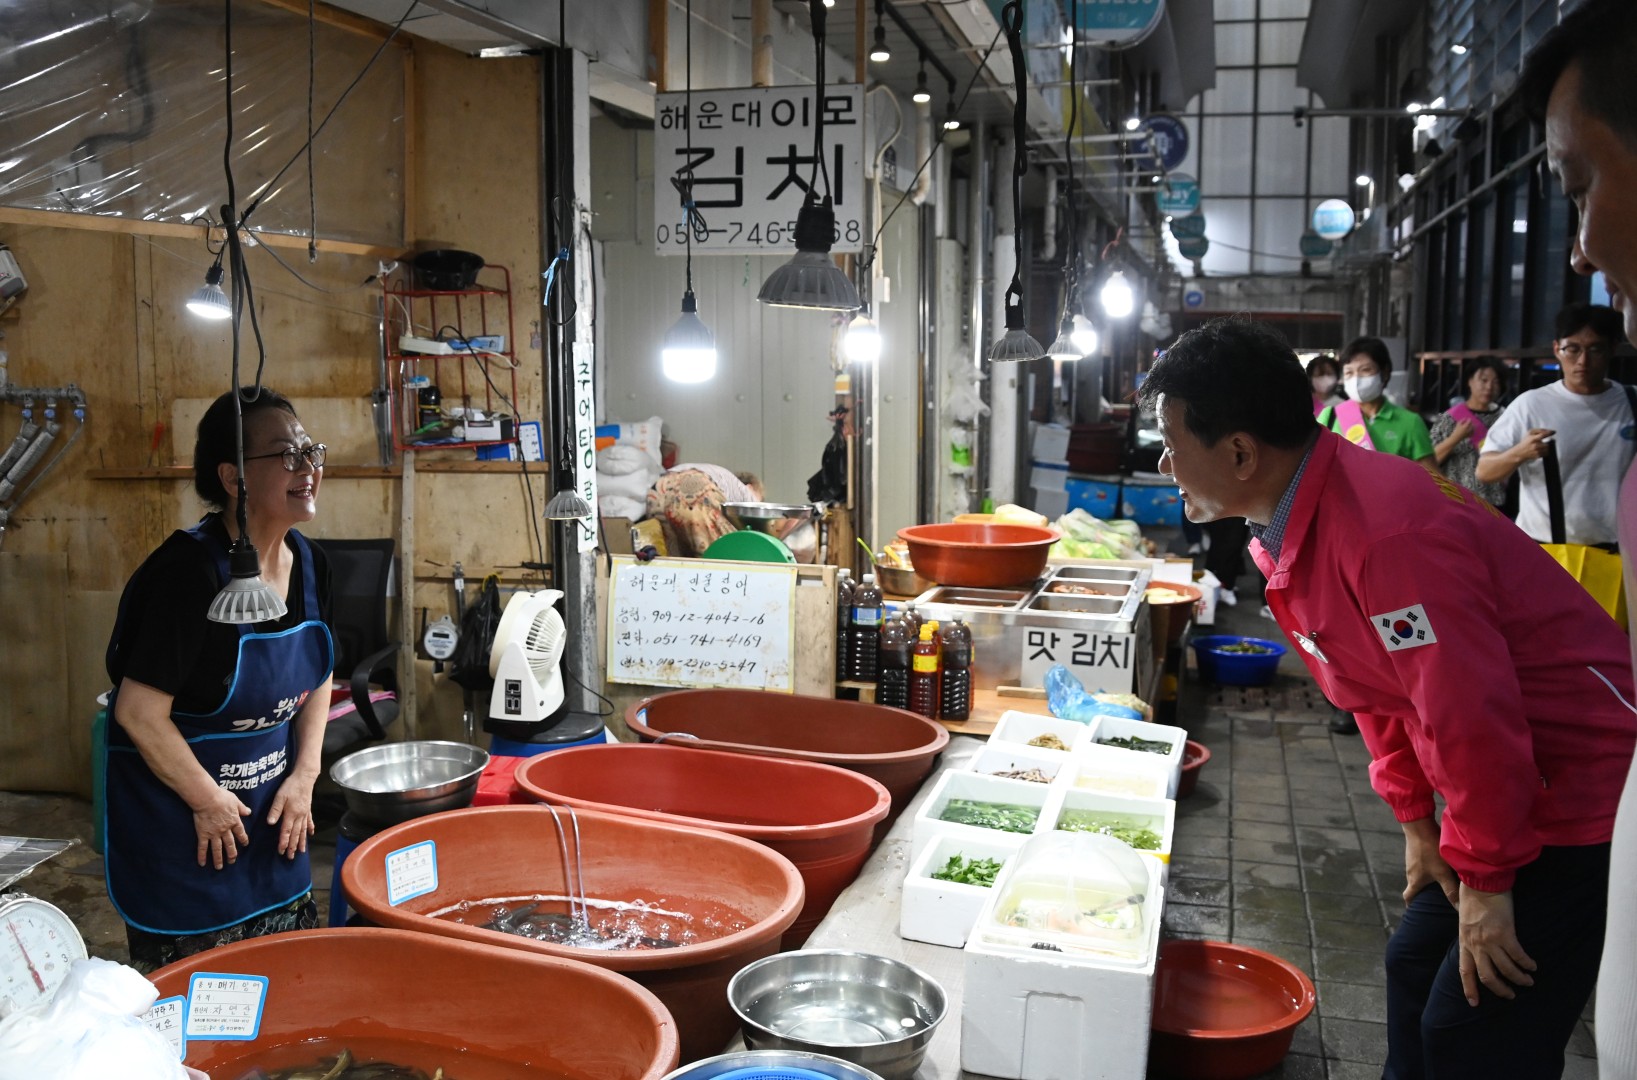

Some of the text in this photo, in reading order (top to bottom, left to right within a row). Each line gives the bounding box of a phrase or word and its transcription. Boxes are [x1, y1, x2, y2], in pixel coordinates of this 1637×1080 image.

[674, 144, 843, 208] 김치
[653, 632, 762, 648] 051-741-4169
[1028, 630, 1130, 669] 맛 김치
